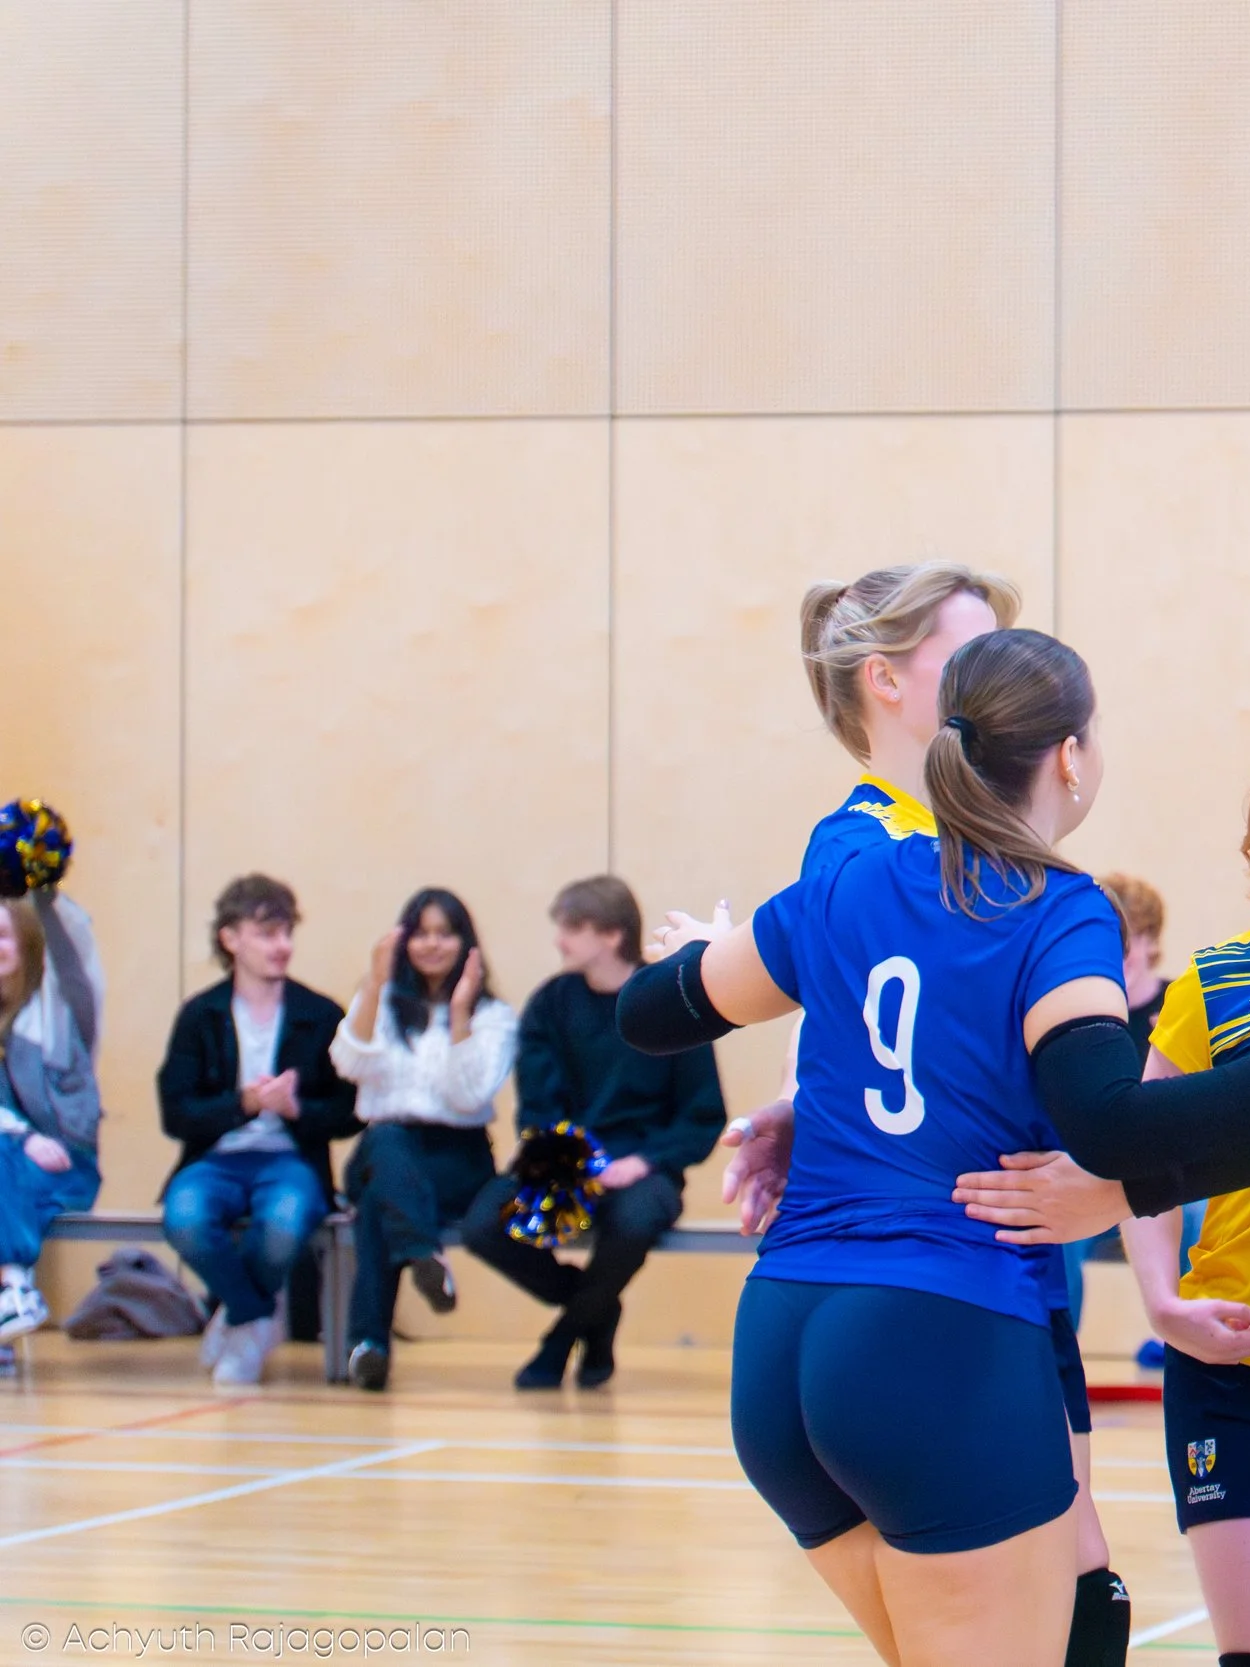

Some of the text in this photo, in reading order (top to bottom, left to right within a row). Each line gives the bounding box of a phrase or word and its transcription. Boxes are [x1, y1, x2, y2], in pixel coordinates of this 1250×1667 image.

[862, 955, 926, 1135] 9
[1189, 1483, 1221, 1495] Abertay
[1187, 1491, 1227, 1504] University
